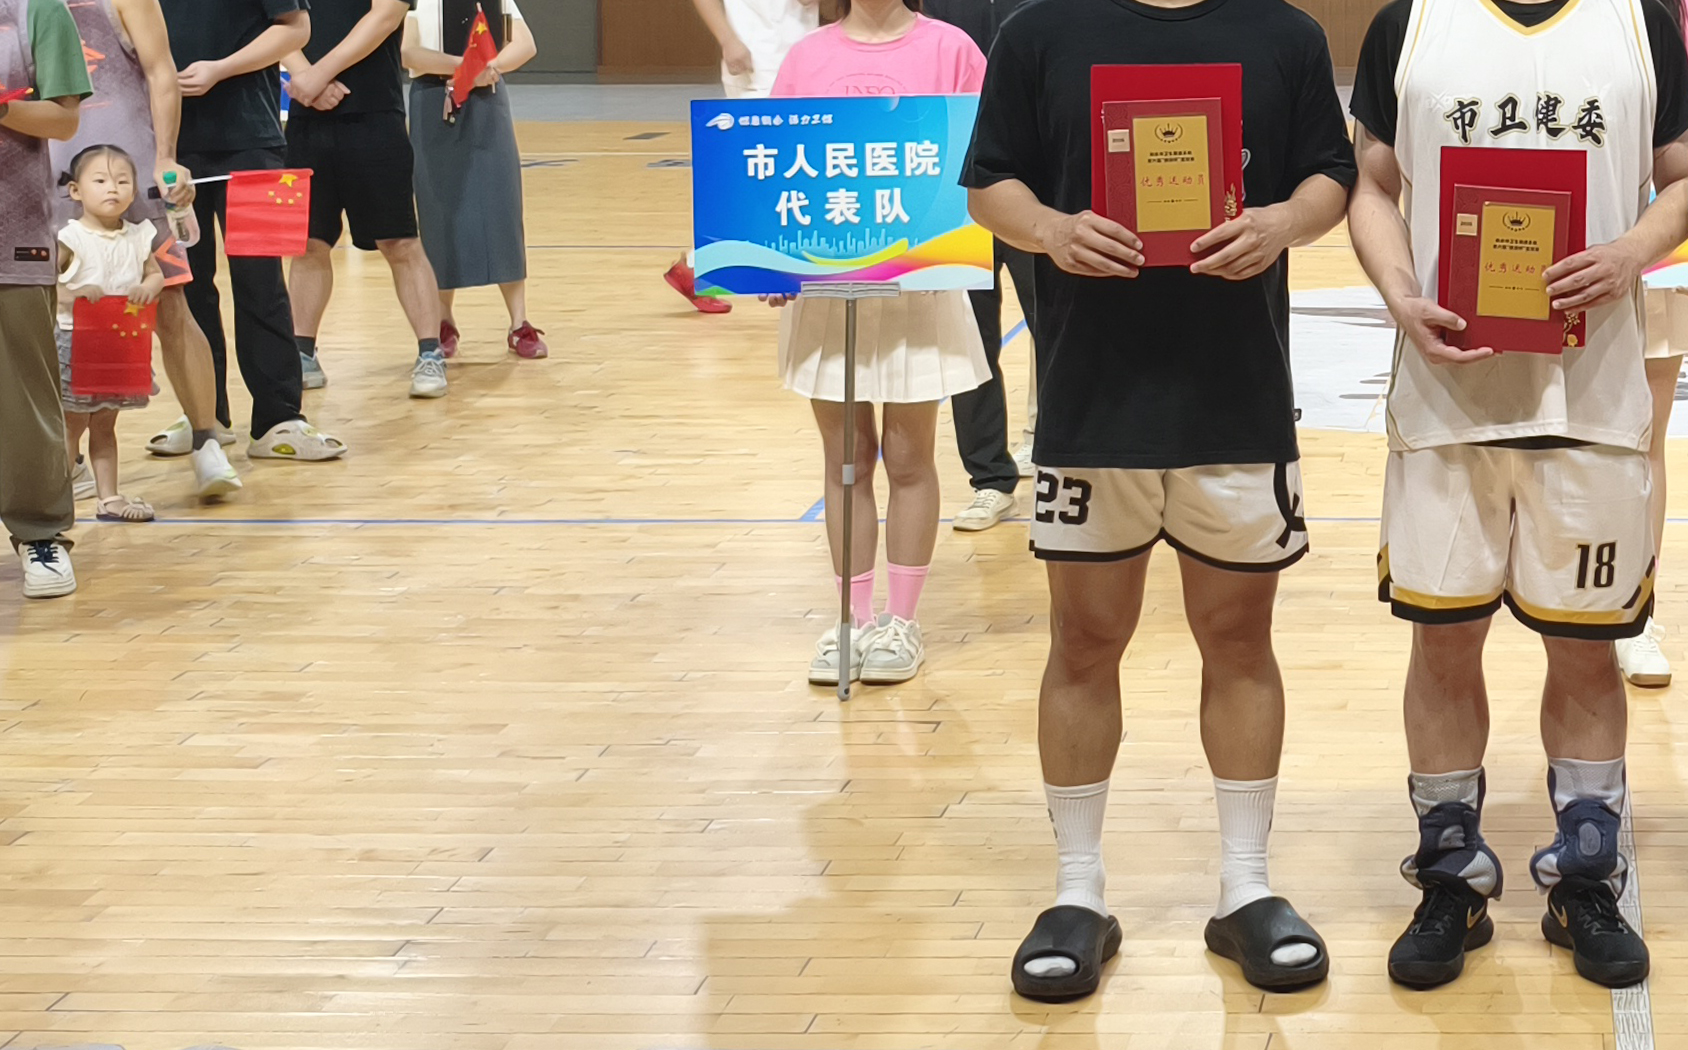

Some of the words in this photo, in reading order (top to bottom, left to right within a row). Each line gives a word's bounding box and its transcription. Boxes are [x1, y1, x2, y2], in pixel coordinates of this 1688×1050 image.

[1445, 94, 1606, 146] 市卫健委
[743, 141, 941, 180] 市人民医院
[775, 187, 911, 226] 代表队
[1036, 470, 1092, 525] 23
[1576, 541, 1617, 589] 18
